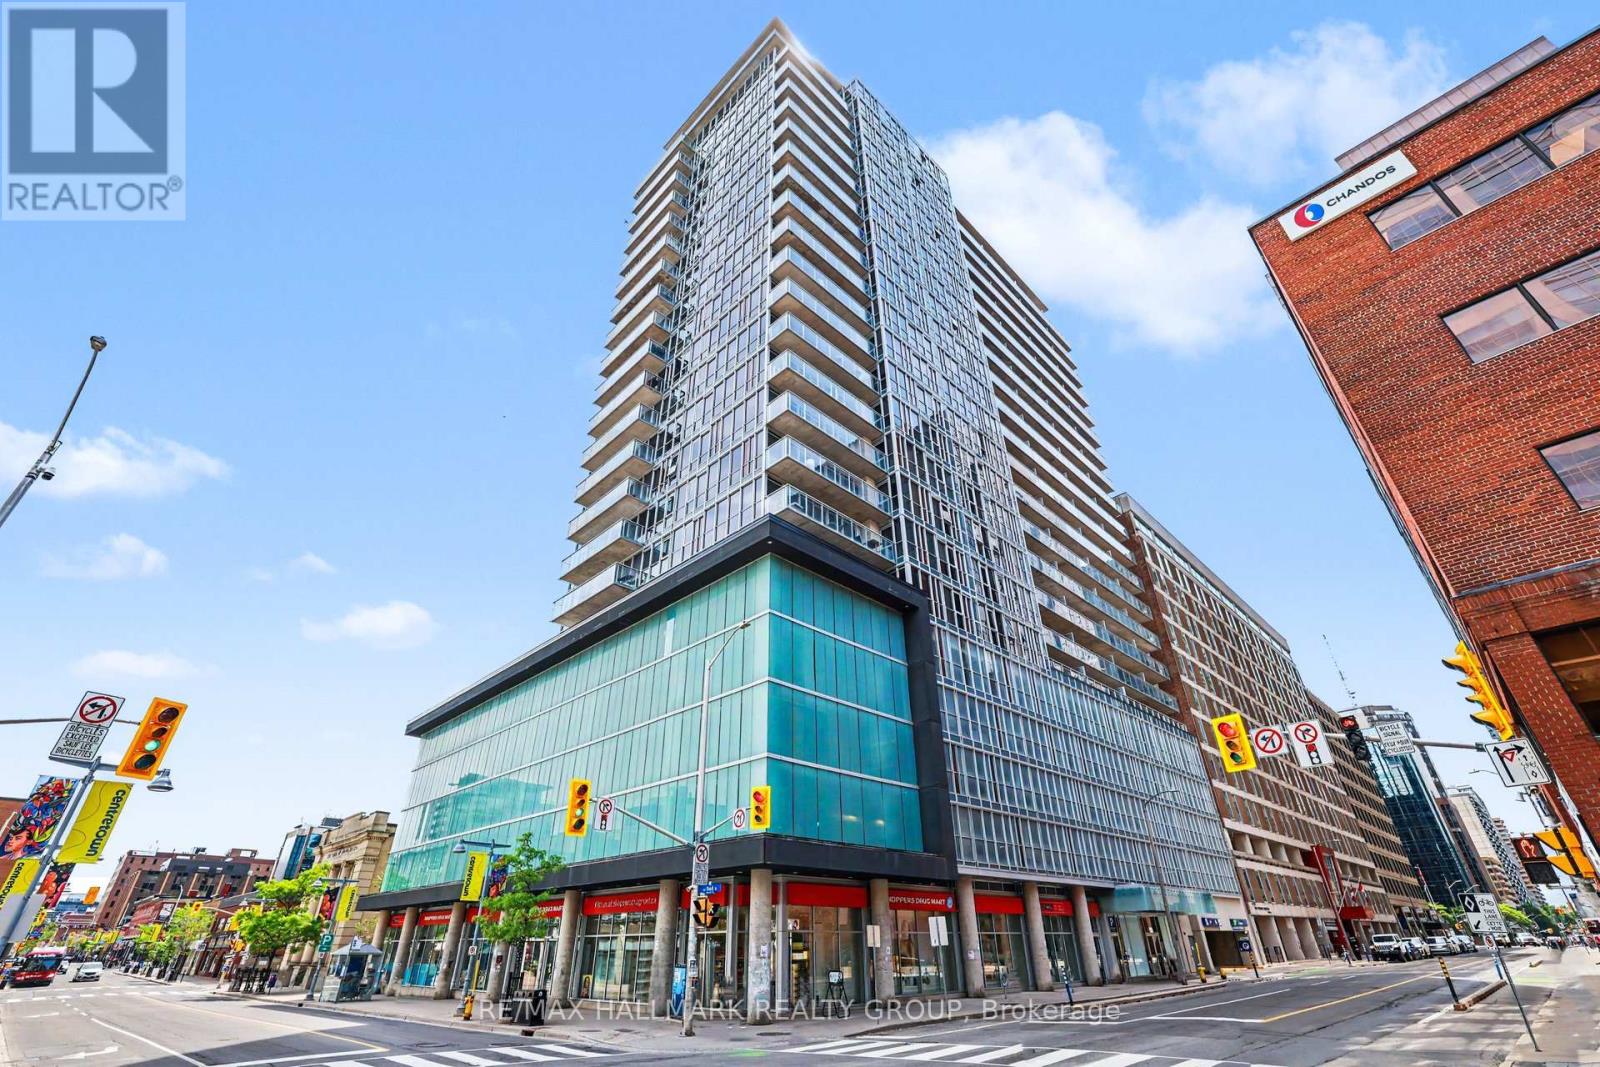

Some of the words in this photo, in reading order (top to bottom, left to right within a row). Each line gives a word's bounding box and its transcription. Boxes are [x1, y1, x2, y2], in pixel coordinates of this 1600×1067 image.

[1326, 165, 1397, 208] CHANDOS
[69, 724, 104, 736] BICYCLES
[65, 732, 99, 743] EXCEPTED
[63, 740, 79, 748] SAUF
[80, 742, 92, 751] LES
[85, 789, 126, 857] centretown
[0, 862, 24, 905] centretow
[889, 896, 915, 904] HOPPERS
[322, 935, 332, 945] P
